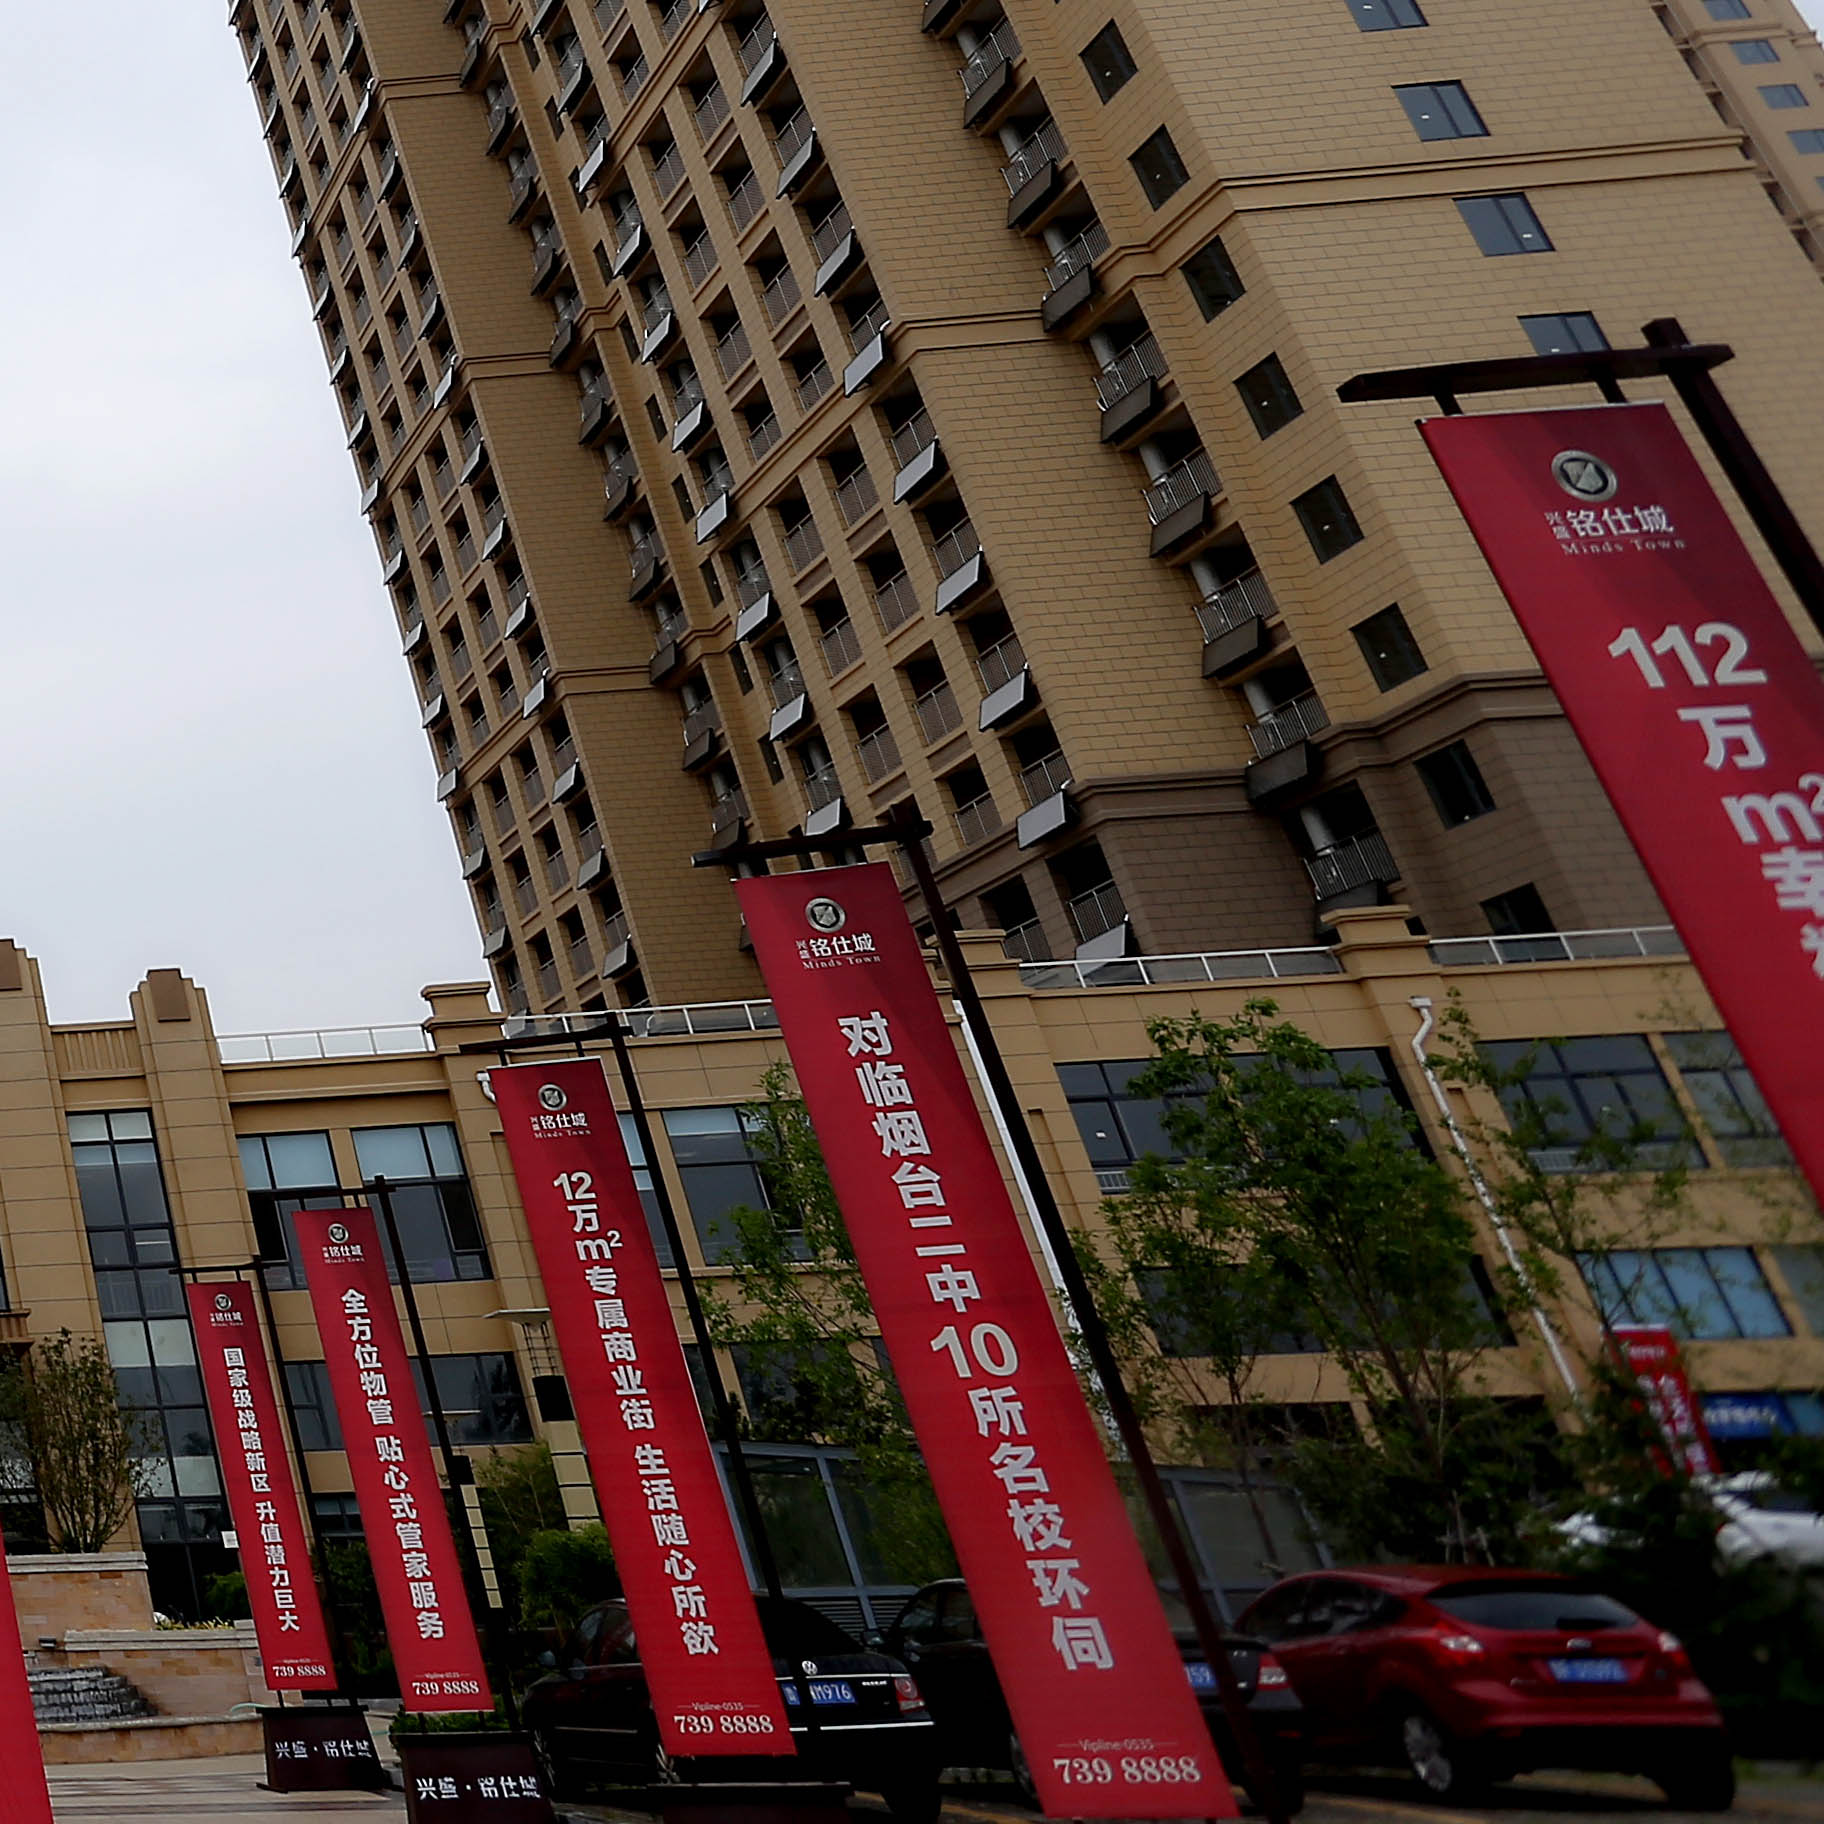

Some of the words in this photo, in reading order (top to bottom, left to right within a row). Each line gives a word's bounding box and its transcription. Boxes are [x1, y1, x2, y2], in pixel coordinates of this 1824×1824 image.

[1566, 504, 1674, 537] 铭仕城
[1560, 541, 1623, 555] Minds
[1630, 539, 1686, 551] Town
[809, 933, 875, 957] 铭仕城
[802, 959, 843, 969] Minds
[846, 956, 880, 965] Town
[838, 1011, 1113, 1671] 对临烟台二中10所名校环伺
[341, 1288, 394, 1425] 全方位物管
[374, 1435, 445, 1639] 贴心式管家服务
[223, 1347, 271, 1493] 国家级战略新区
[255, 1501, 300, 1632] 升值潜力巨大
[634, 1443, 719, 1656] 生活随心所欲
[272, 1665, 294, 1677] 739
[297, 1665, 327, 1676] 8888
[412, 1682, 439, 1695] 739
[443, 1680, 480, 1694] 8888
[674, 1715, 714, 1734] 739
[719, 1714, 774, 1734] 8888
[1052, 1757, 1113, 1784] 739
[1120, 1756, 1201, 1783] 8888
